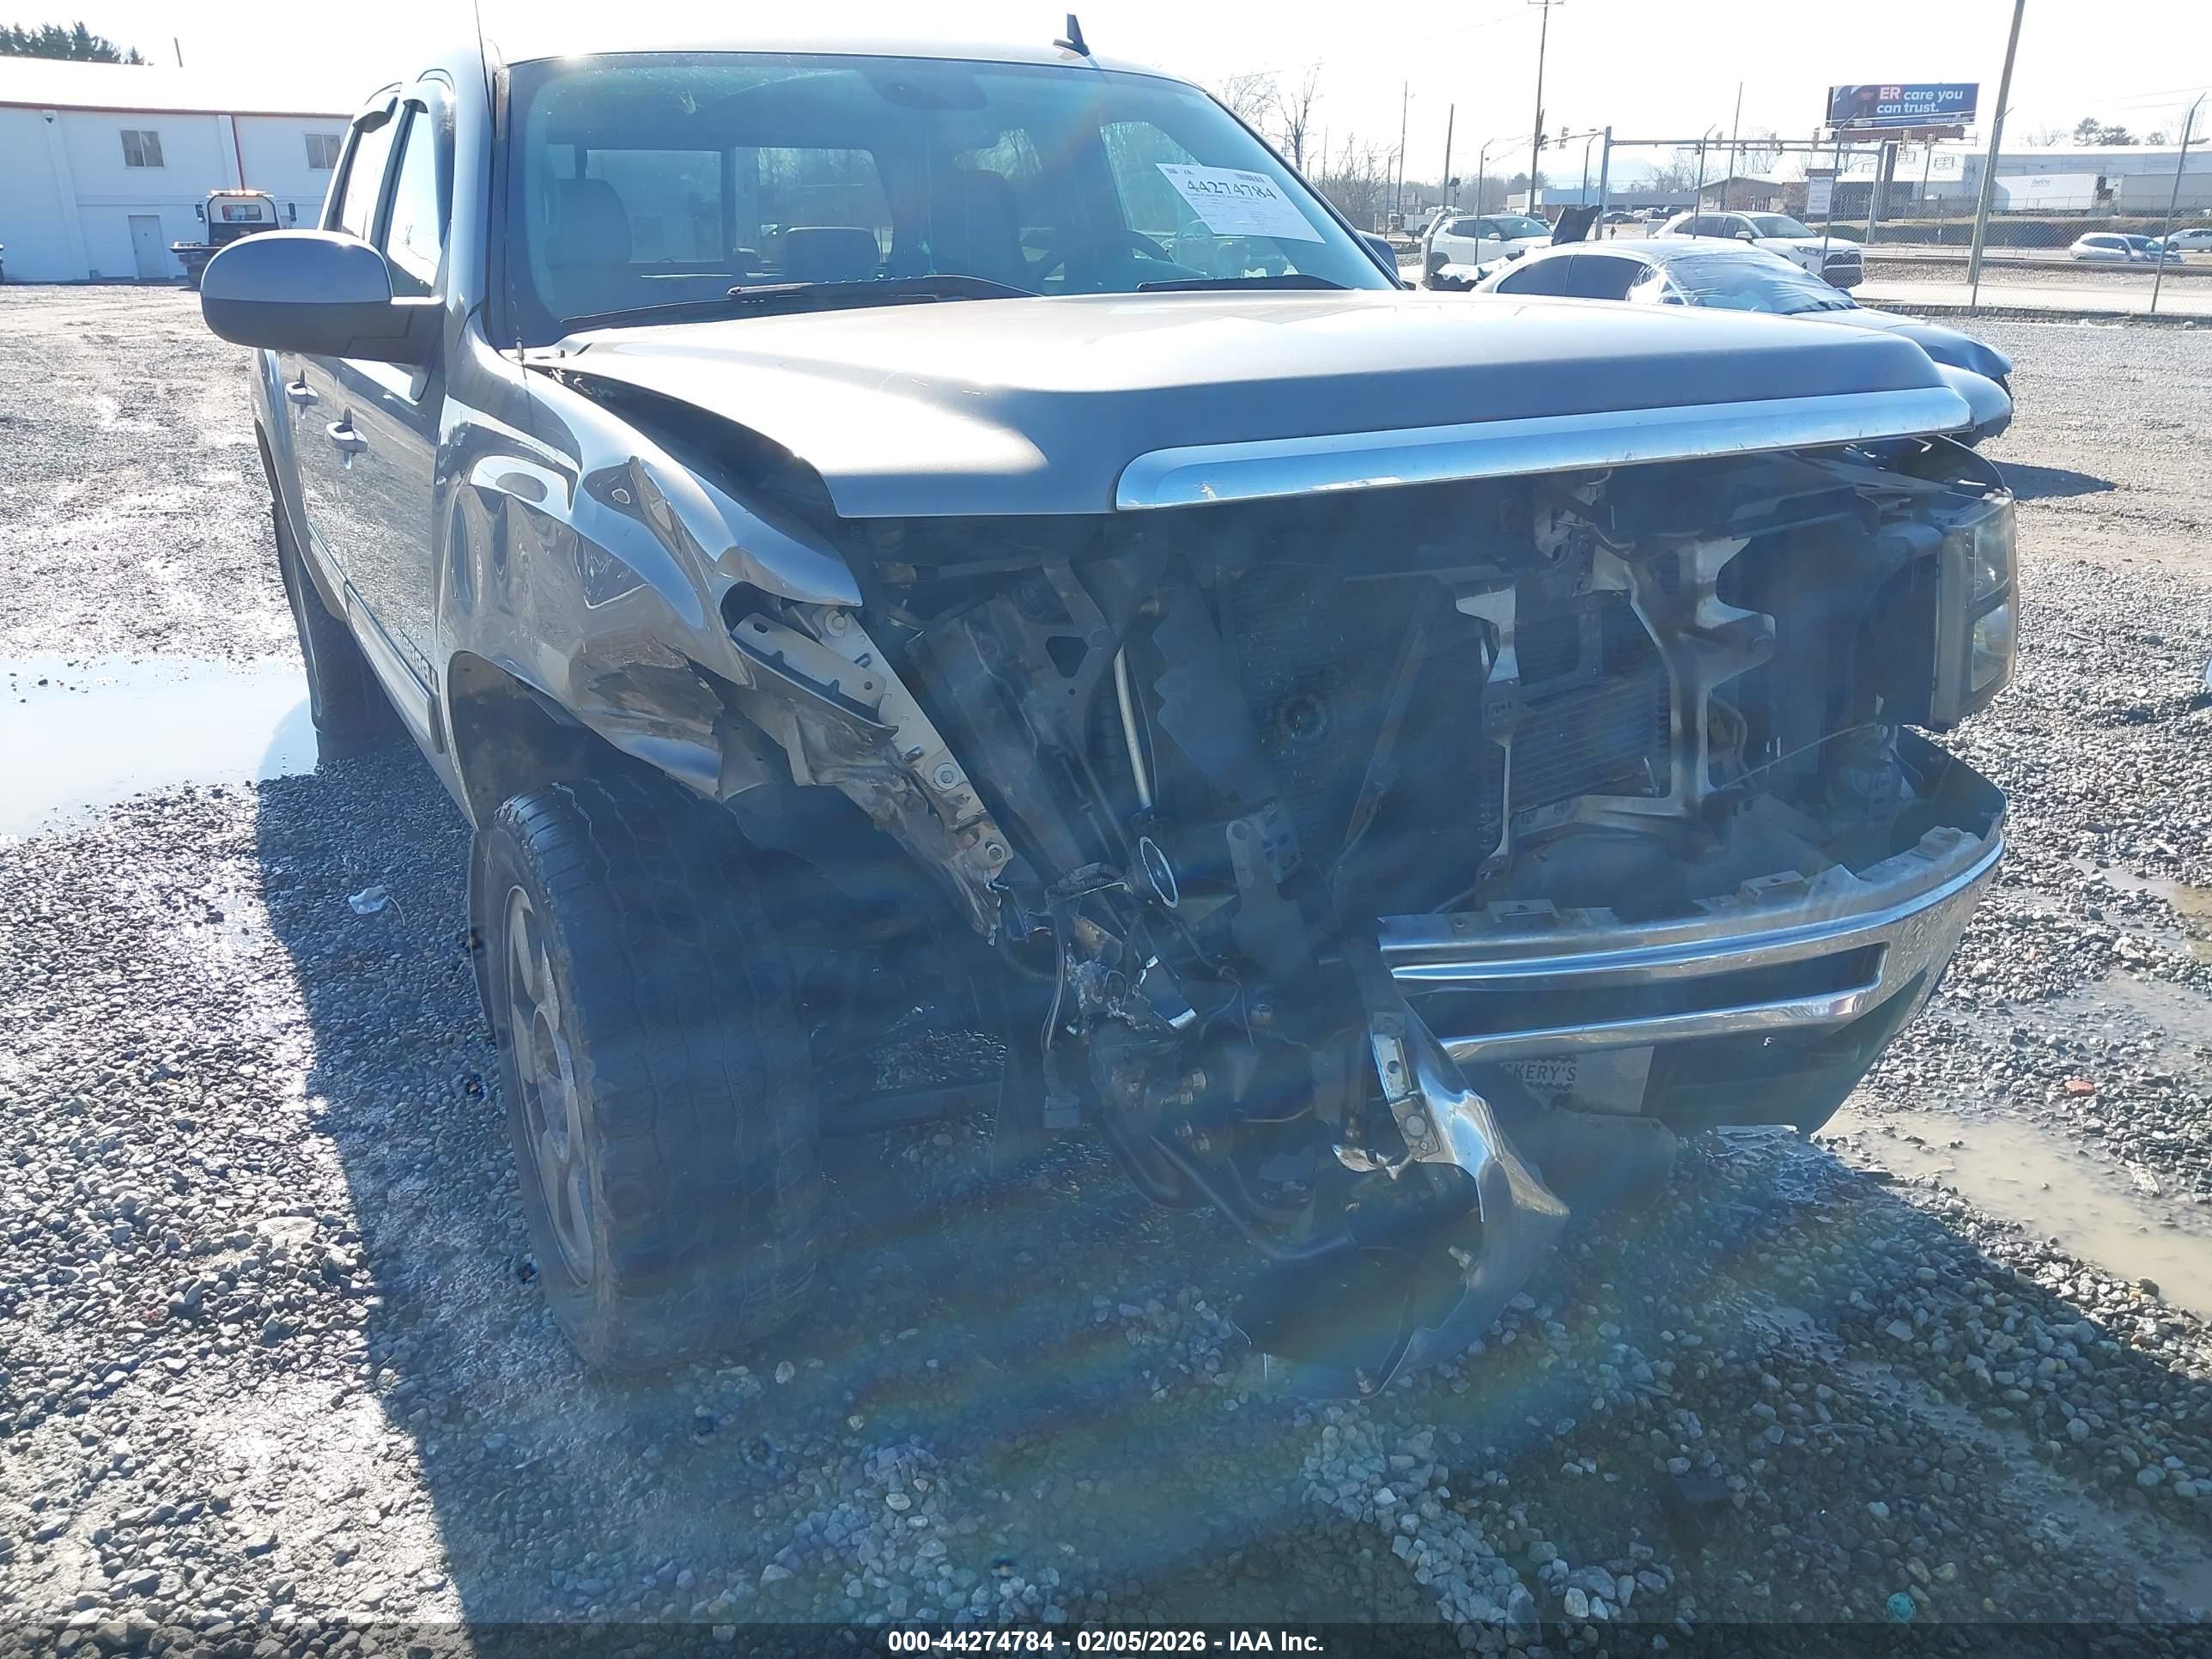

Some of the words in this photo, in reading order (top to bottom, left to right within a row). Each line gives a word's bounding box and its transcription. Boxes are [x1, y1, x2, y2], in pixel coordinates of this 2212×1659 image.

[1880, 87, 1901, 100] ER
[1904, 91, 1934, 100] care
[1937, 90, 1963, 102] you
[1876, 104, 1901, 113] can
[1904, 102, 1939, 112] trust.
[1187, 179, 1277, 200] 44274784
